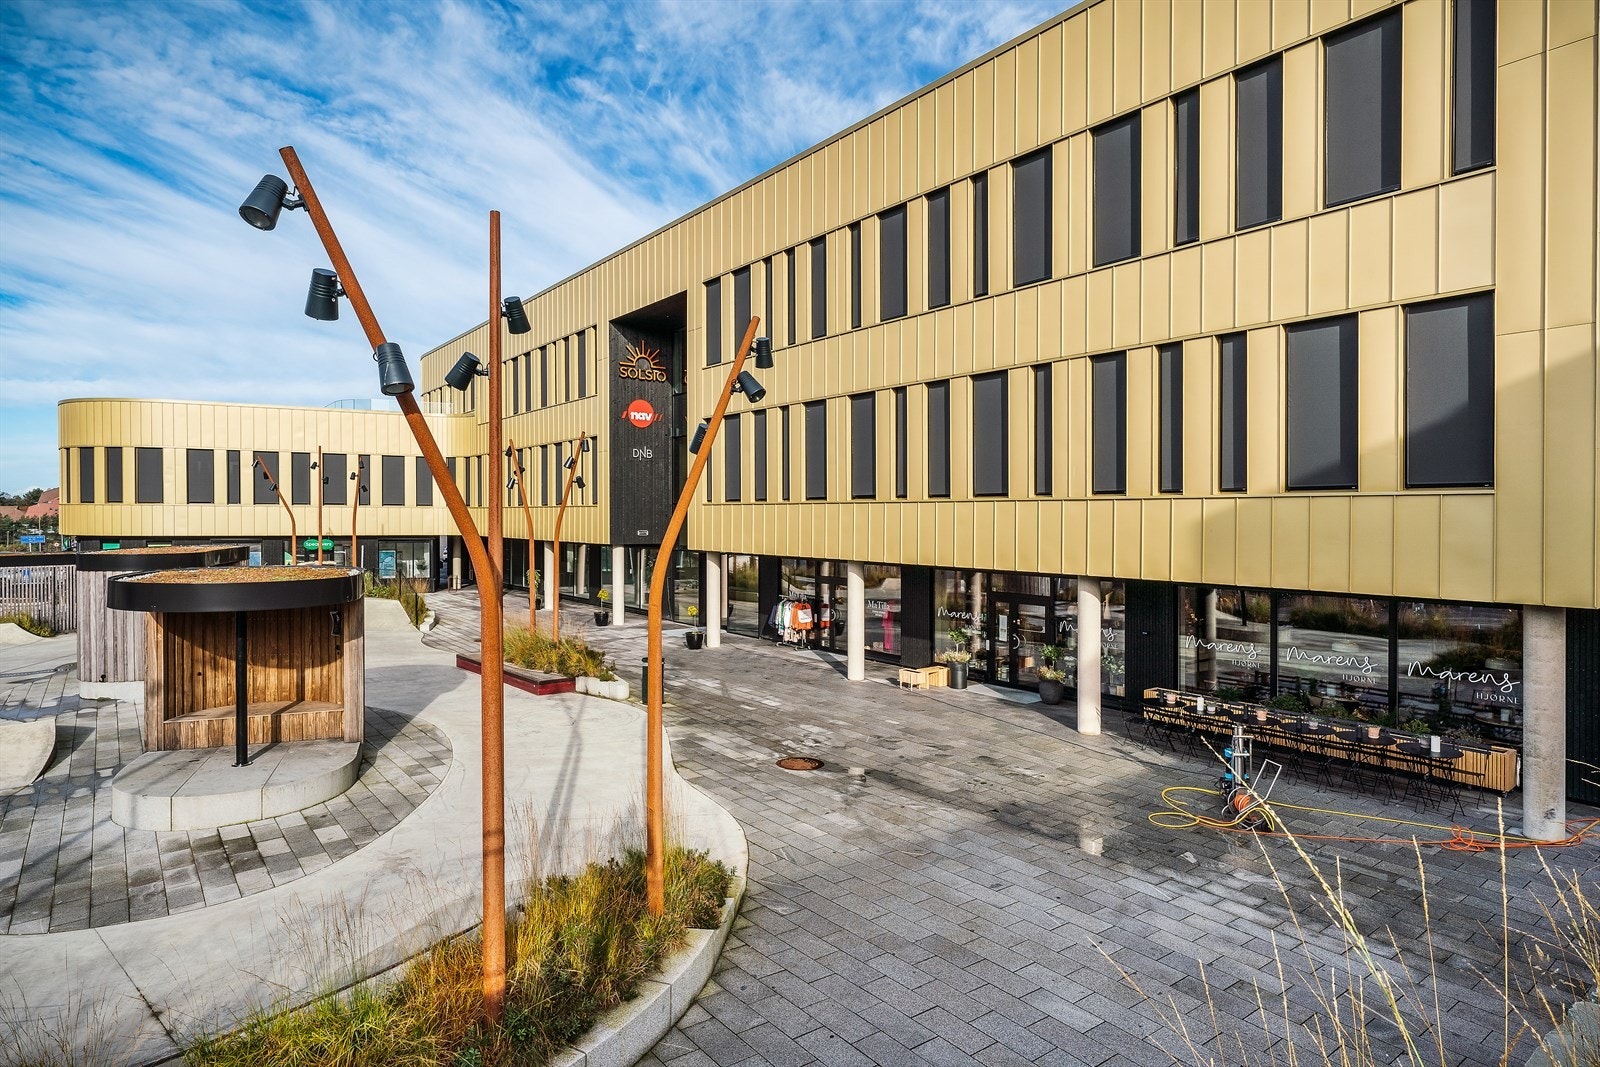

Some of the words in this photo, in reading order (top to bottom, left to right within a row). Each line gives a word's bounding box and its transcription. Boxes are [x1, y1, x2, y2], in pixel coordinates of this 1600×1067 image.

[630, 411, 653, 421] nav
[632, 446, 653, 461] DNB
[1185, 634, 1262, 659] Marens
[1286, 646, 1379, 675] Marens
[1407, 660, 1521, 693] Marens
[1476, 691, 1521, 705] HJØRNE
